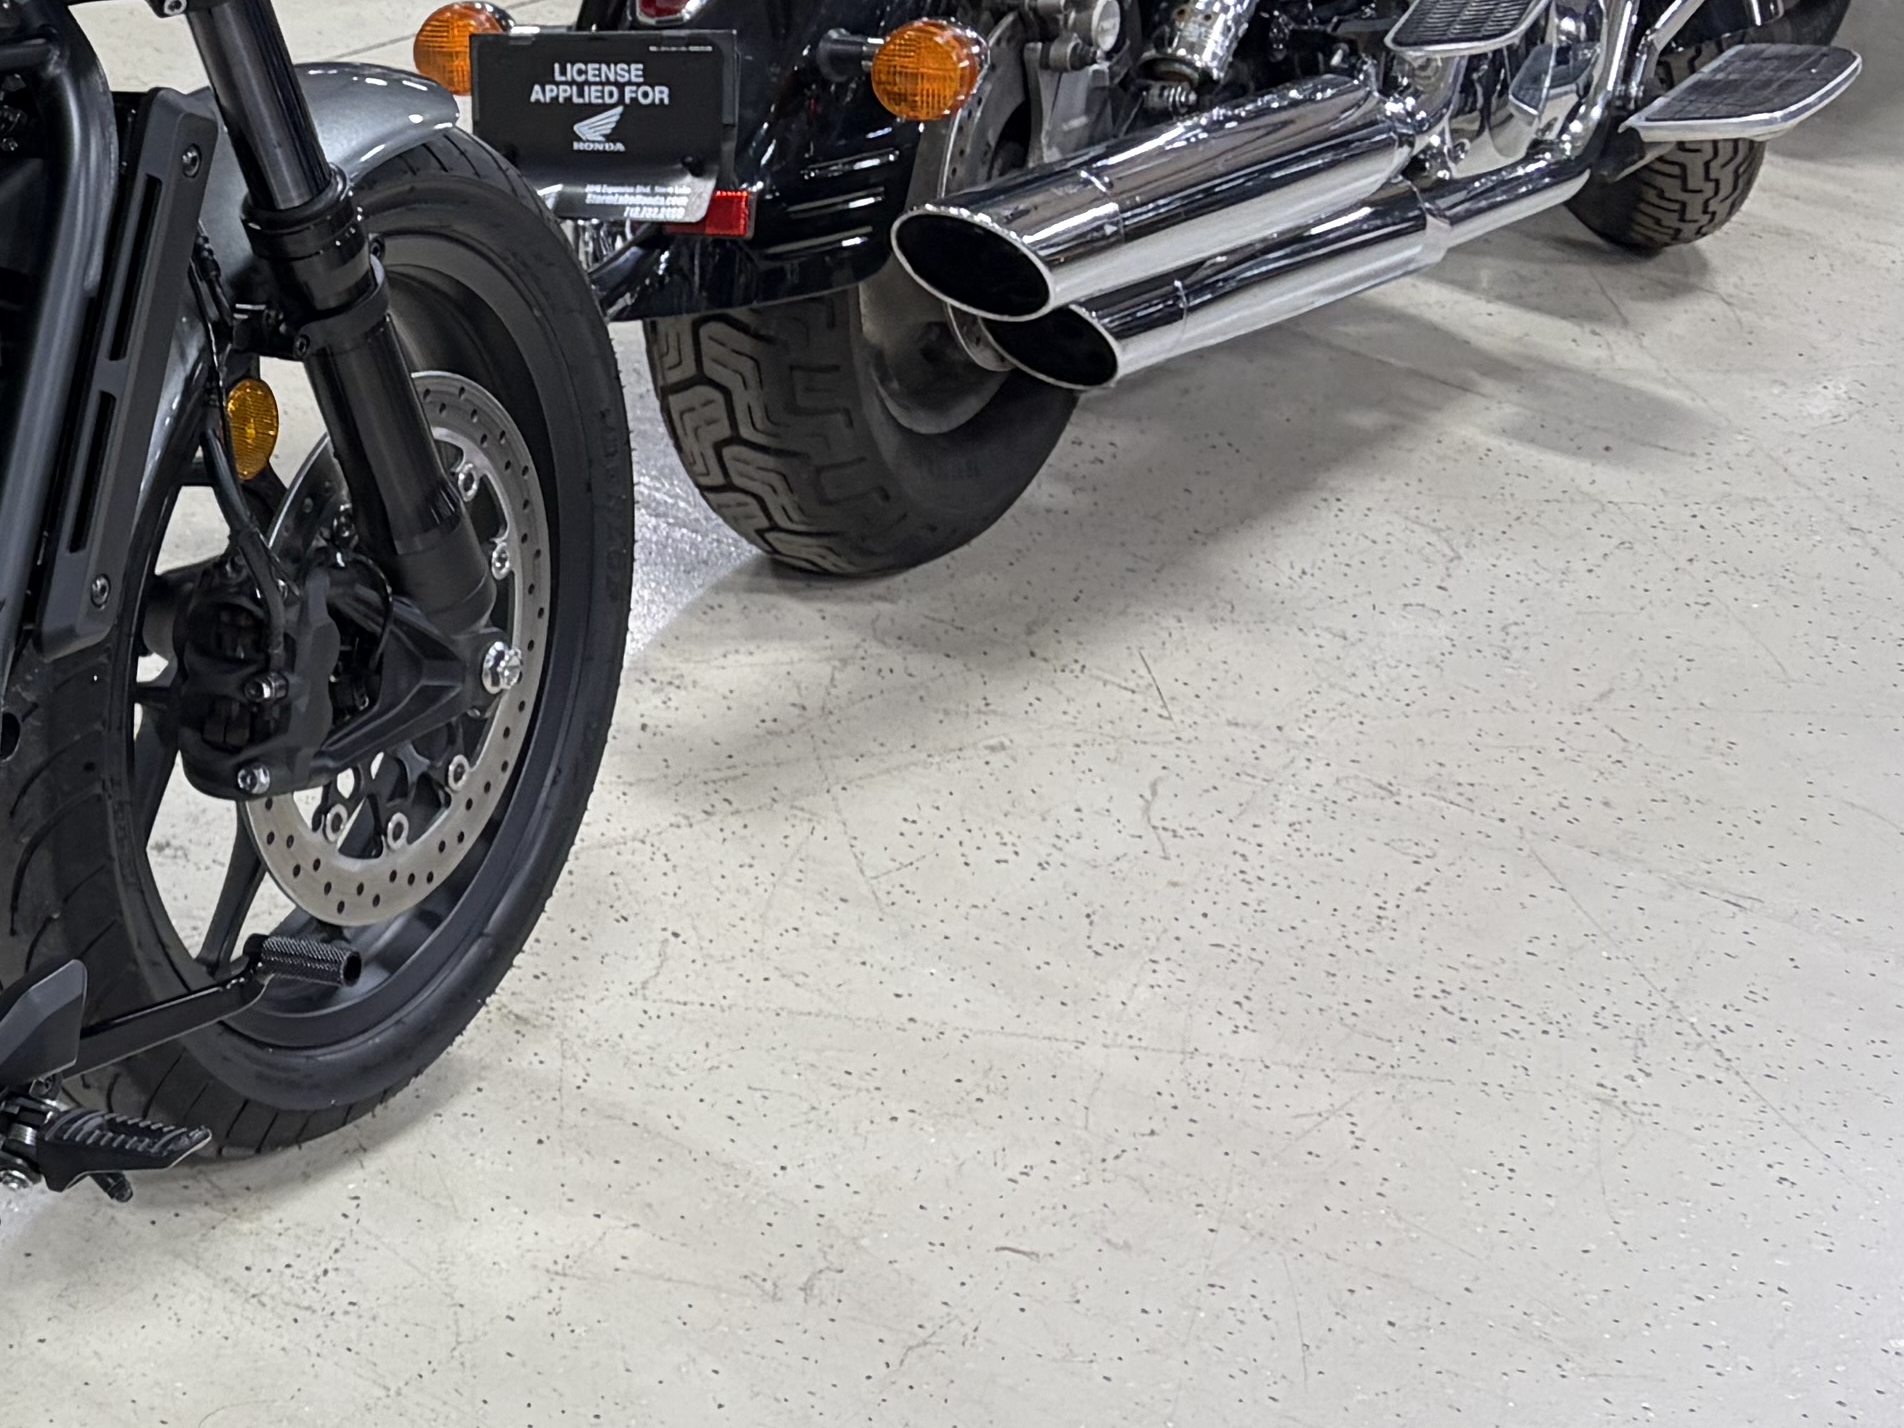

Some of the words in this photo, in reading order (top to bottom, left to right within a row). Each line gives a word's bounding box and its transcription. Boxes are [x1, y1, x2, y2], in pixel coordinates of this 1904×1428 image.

[553, 62, 645, 83] LICENSE
[529, 84, 619, 104] APPLIED
[624, 85, 670, 106] FOR
[572, 141, 626, 152] HONDA
